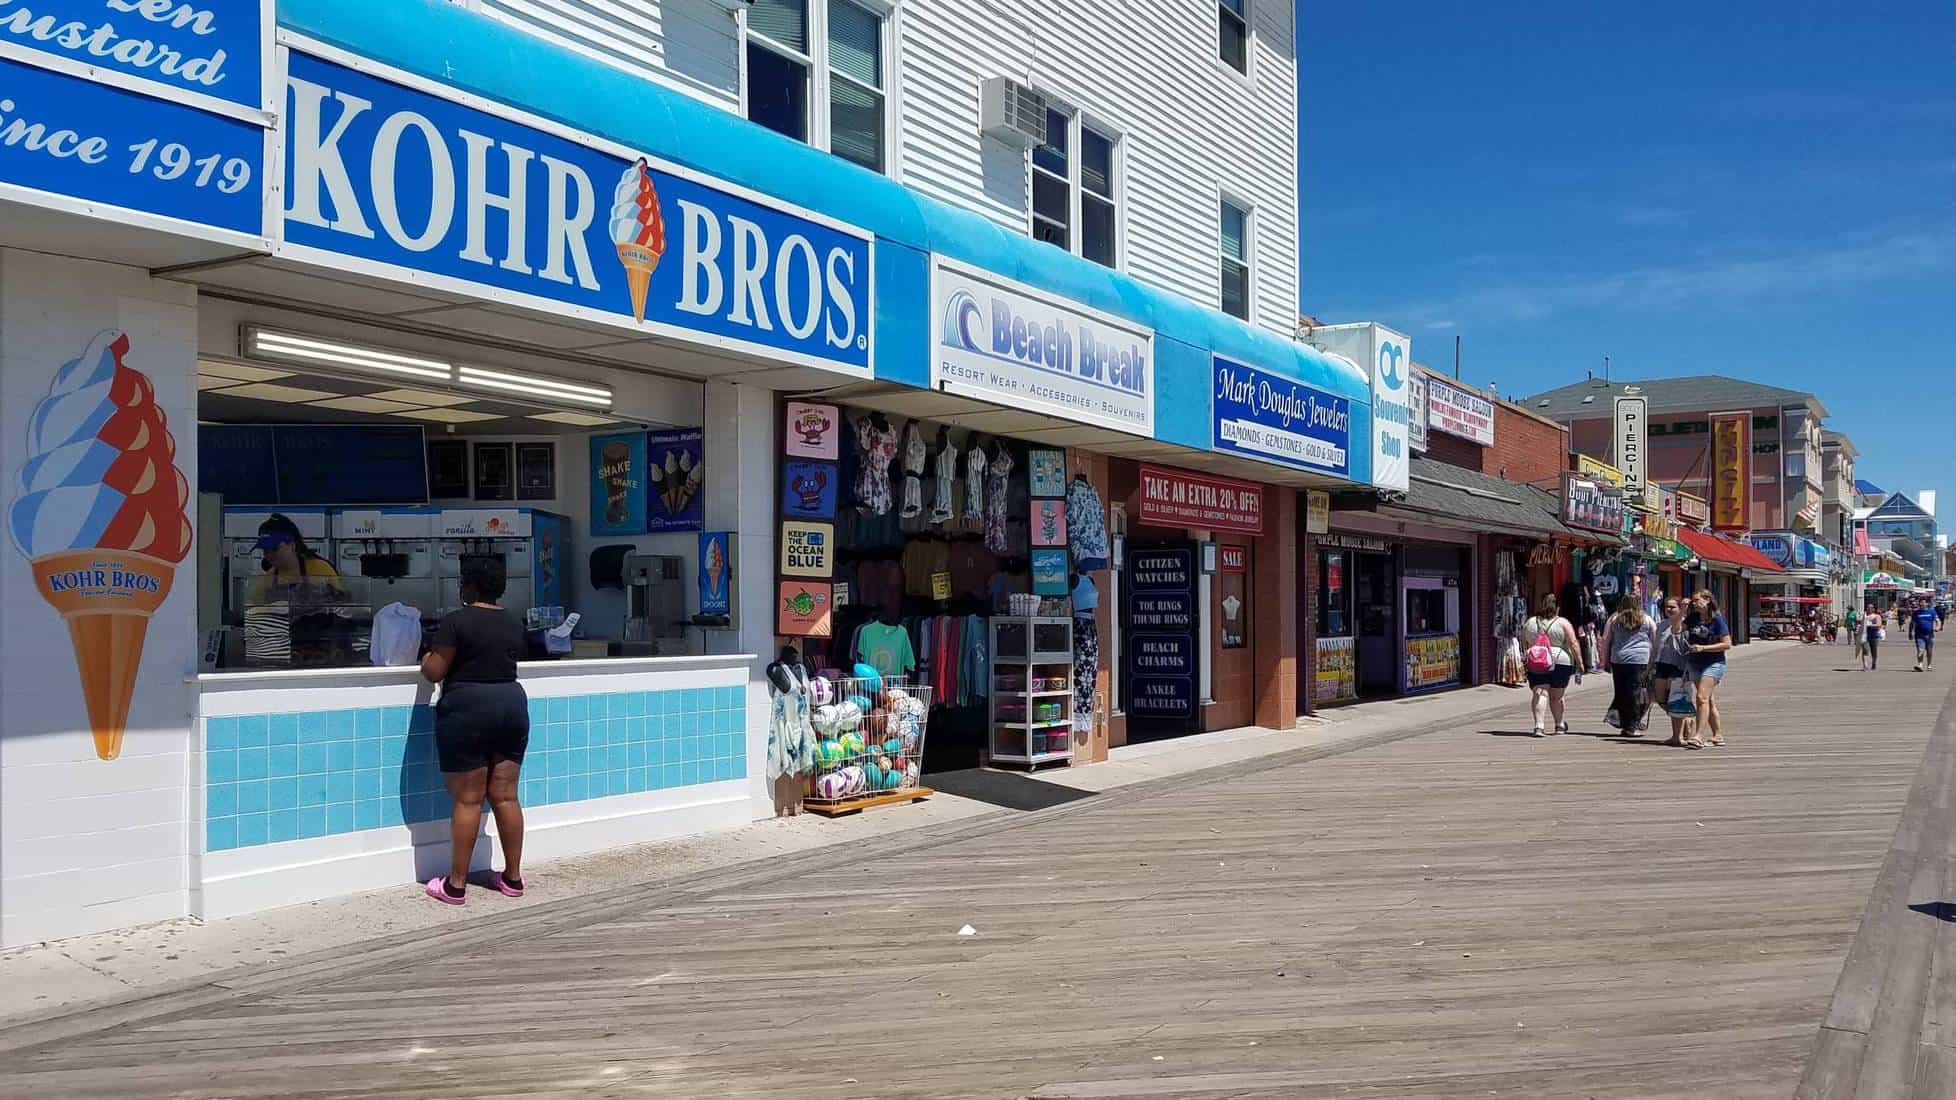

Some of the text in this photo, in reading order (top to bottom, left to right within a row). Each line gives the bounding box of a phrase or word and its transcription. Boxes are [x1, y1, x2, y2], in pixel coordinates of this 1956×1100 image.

[0, 7, 227, 86] ustard
[128, 138, 251, 194] 1919
[284, 76, 857, 350] KOHR BROS
[991, 297, 1145, 394] Beach Break
[1217, 368, 1349, 433] Mark Douglas Jewelers
[1375, 393, 1409, 426] Souvenir
[1223, 422, 1261, 444] DIAMONDS
[1265, 430, 1301, 452] GEMSTONES
[1305, 440, 1321, 459] GOLD
[1326, 445, 1345, 464] SILVER
[1381, 430, 1401, 461] Shop
[1720, 420, 1738, 464] FUN
[1624, 414, 1638, 493] PIERCING
[598, 460, 632, 479] SHAKE
[612, 477, 640, 489] SHAKE
[1143, 476, 1169, 501] TAKE
[1172, 481, 1186, 504] AN
[1188, 483, 1218, 508] EXTRA
[1219, 488, 1238, 511] 20%
[1720, 468, 1740, 525] CITY
[788, 530, 808, 538] KEEP
[788, 537, 802, 545] THE
[788, 545, 824, 555] OCEAN
[1223, 550, 1243, 567] SALE
[788, 555, 824, 568] BLUE
[1138, 557, 1182, 569] CITIZEN
[50, 570, 160, 593] KOHR BROS
[1135, 571, 1186, 583] WATCHES
[1139, 600, 1182, 611] TOE RINGS
[1133, 613, 1189, 625] THUMB RINGS
[1143, 642, 1179, 653] BEACH
[1137, 655, 1184, 667] CHARMS
[1145, 684, 1176, 696] ANKLE
[1133, 698, 1188, 710] BRACELETS
